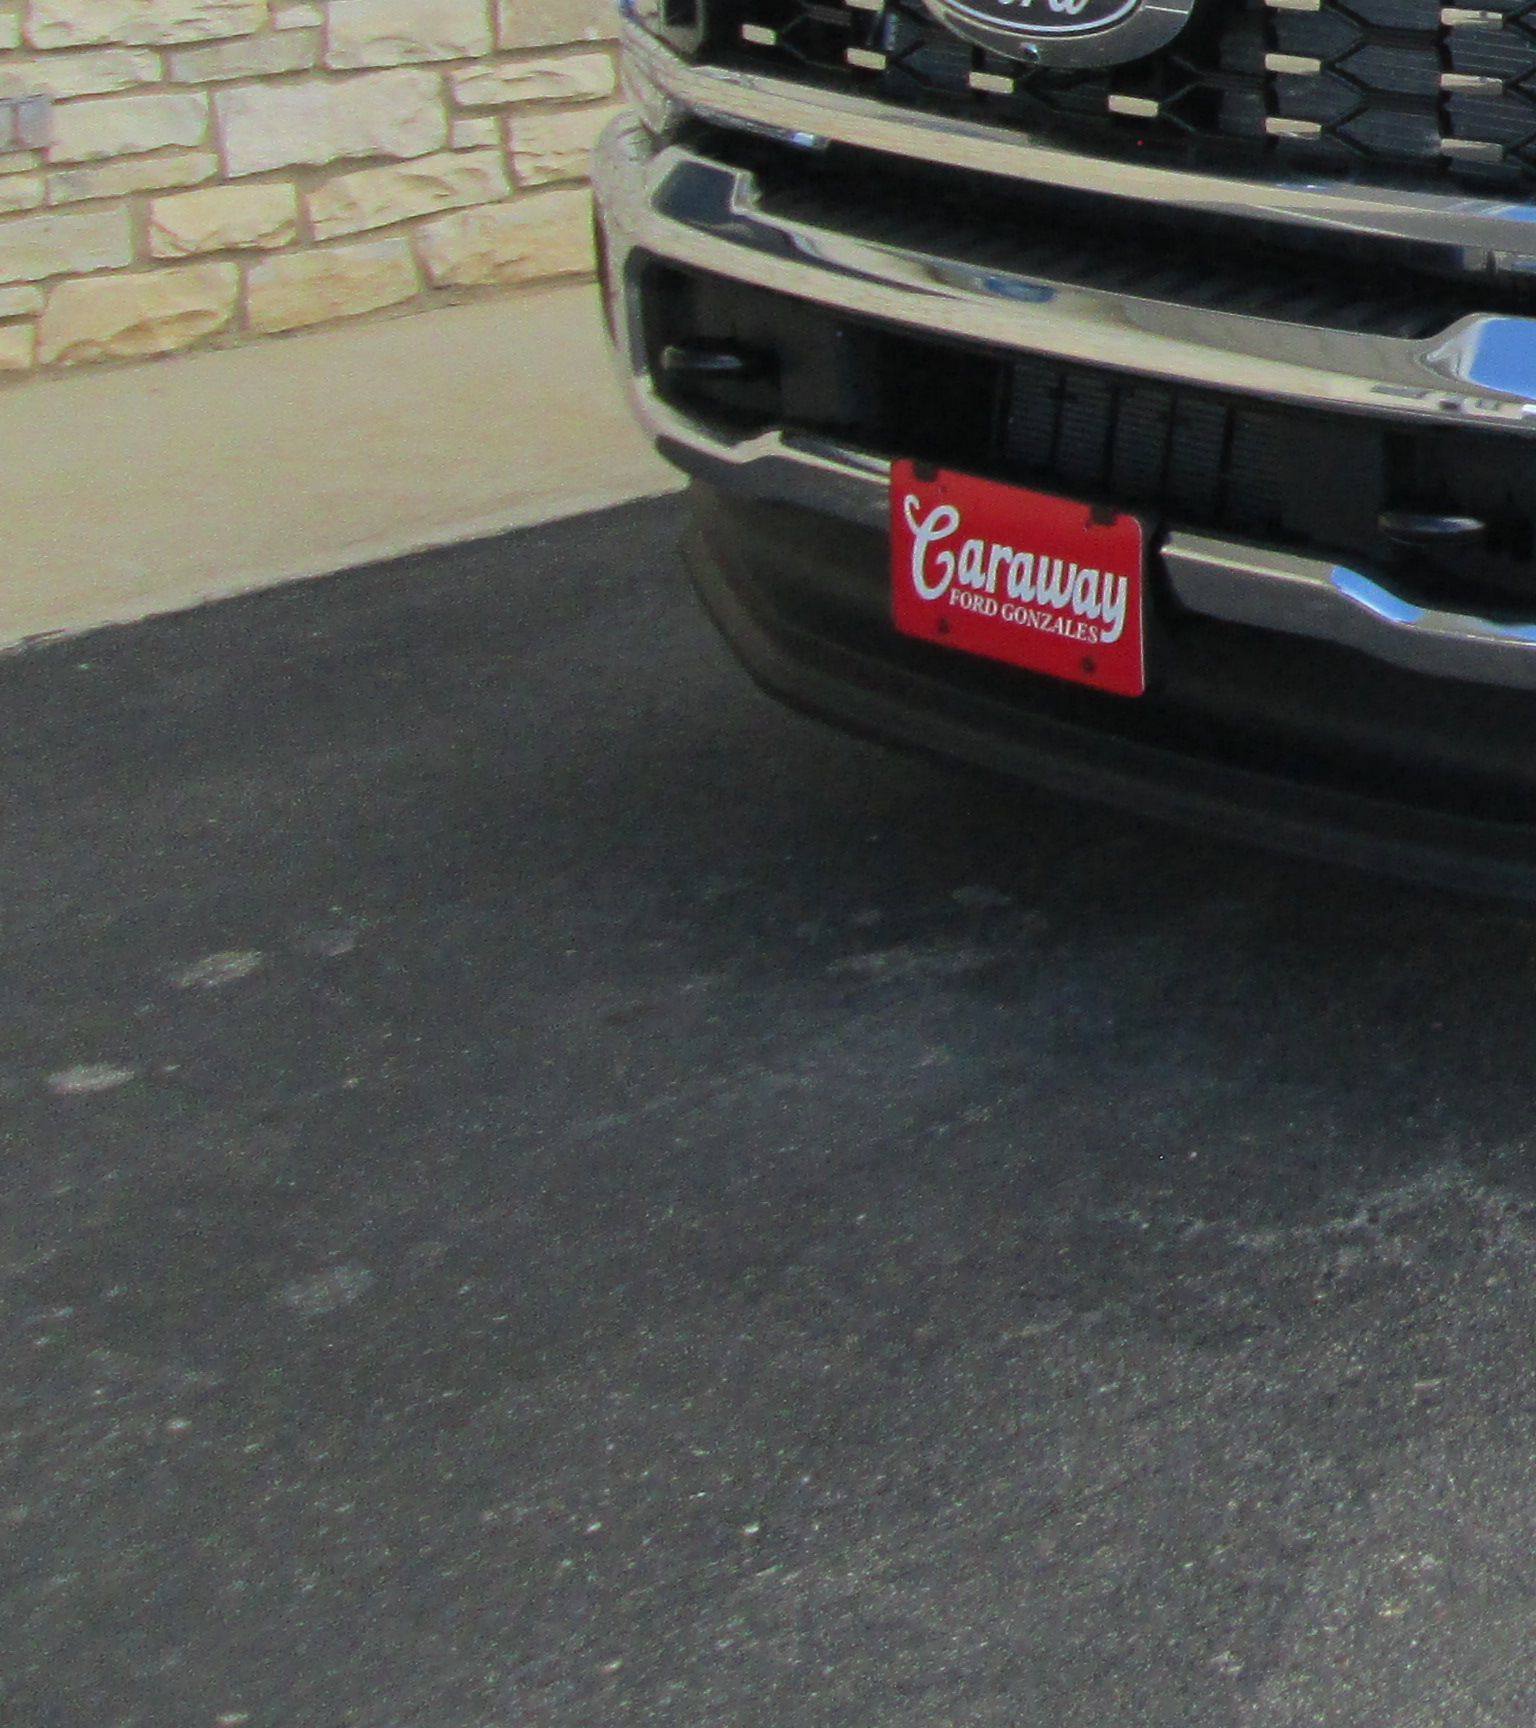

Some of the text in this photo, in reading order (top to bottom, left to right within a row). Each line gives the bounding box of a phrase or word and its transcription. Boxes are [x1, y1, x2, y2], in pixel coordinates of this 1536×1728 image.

[904, 494, 1128, 644] Caraway
[949, 587, 1099, 645] FORD GONZALES
